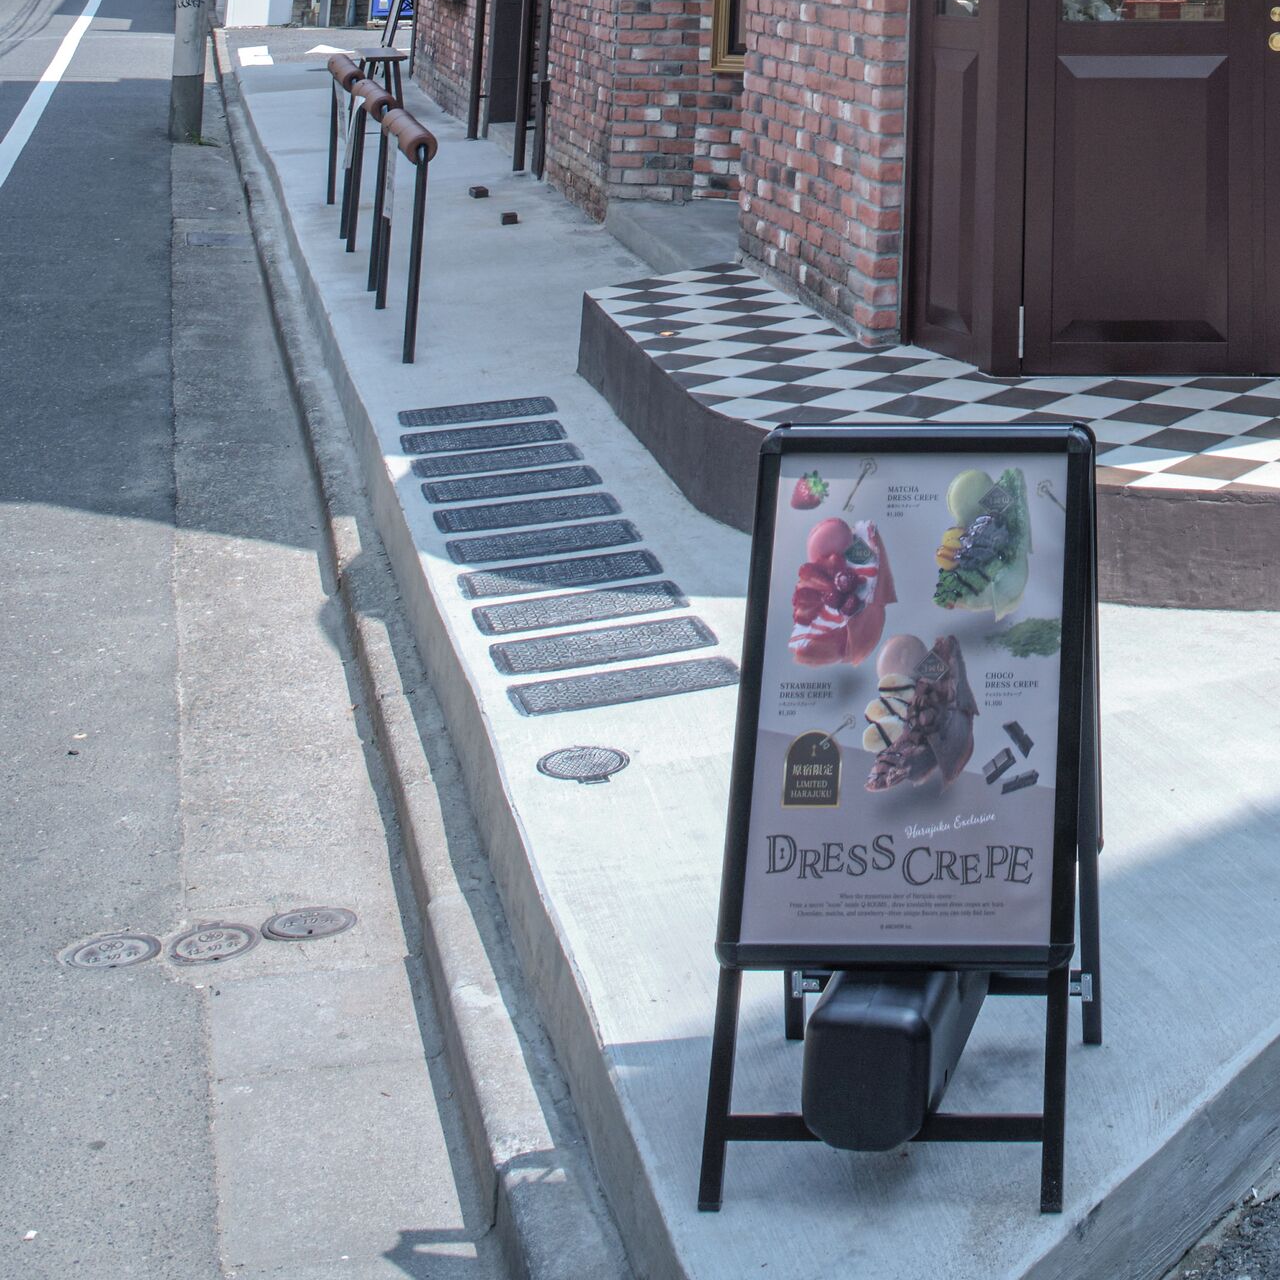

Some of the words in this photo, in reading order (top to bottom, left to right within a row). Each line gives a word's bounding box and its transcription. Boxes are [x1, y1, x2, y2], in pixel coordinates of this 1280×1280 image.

[887, 485, 920, 493] MATCHA
[985, 671, 1014, 680] CHOCO
[779, 681, 833, 690] STRAWBERRY
[984, 680, 1011, 689] DRESS
[1012, 680, 1039, 689] CREPE
[779, 690, 805, 699] DRESS
[807, 690, 833, 699] CREPE
[792, 763, 834, 776] 原宿限定
[796, 779, 828, 789] LIMITED
[790, 789, 832, 799] HARAJUKU
[904, 820, 951, 840] Harajuku
[952, 812, 997, 830] Exclusive
[765, 833, 896, 880] DRESS
[901, 844, 1035, 886] CREPE
